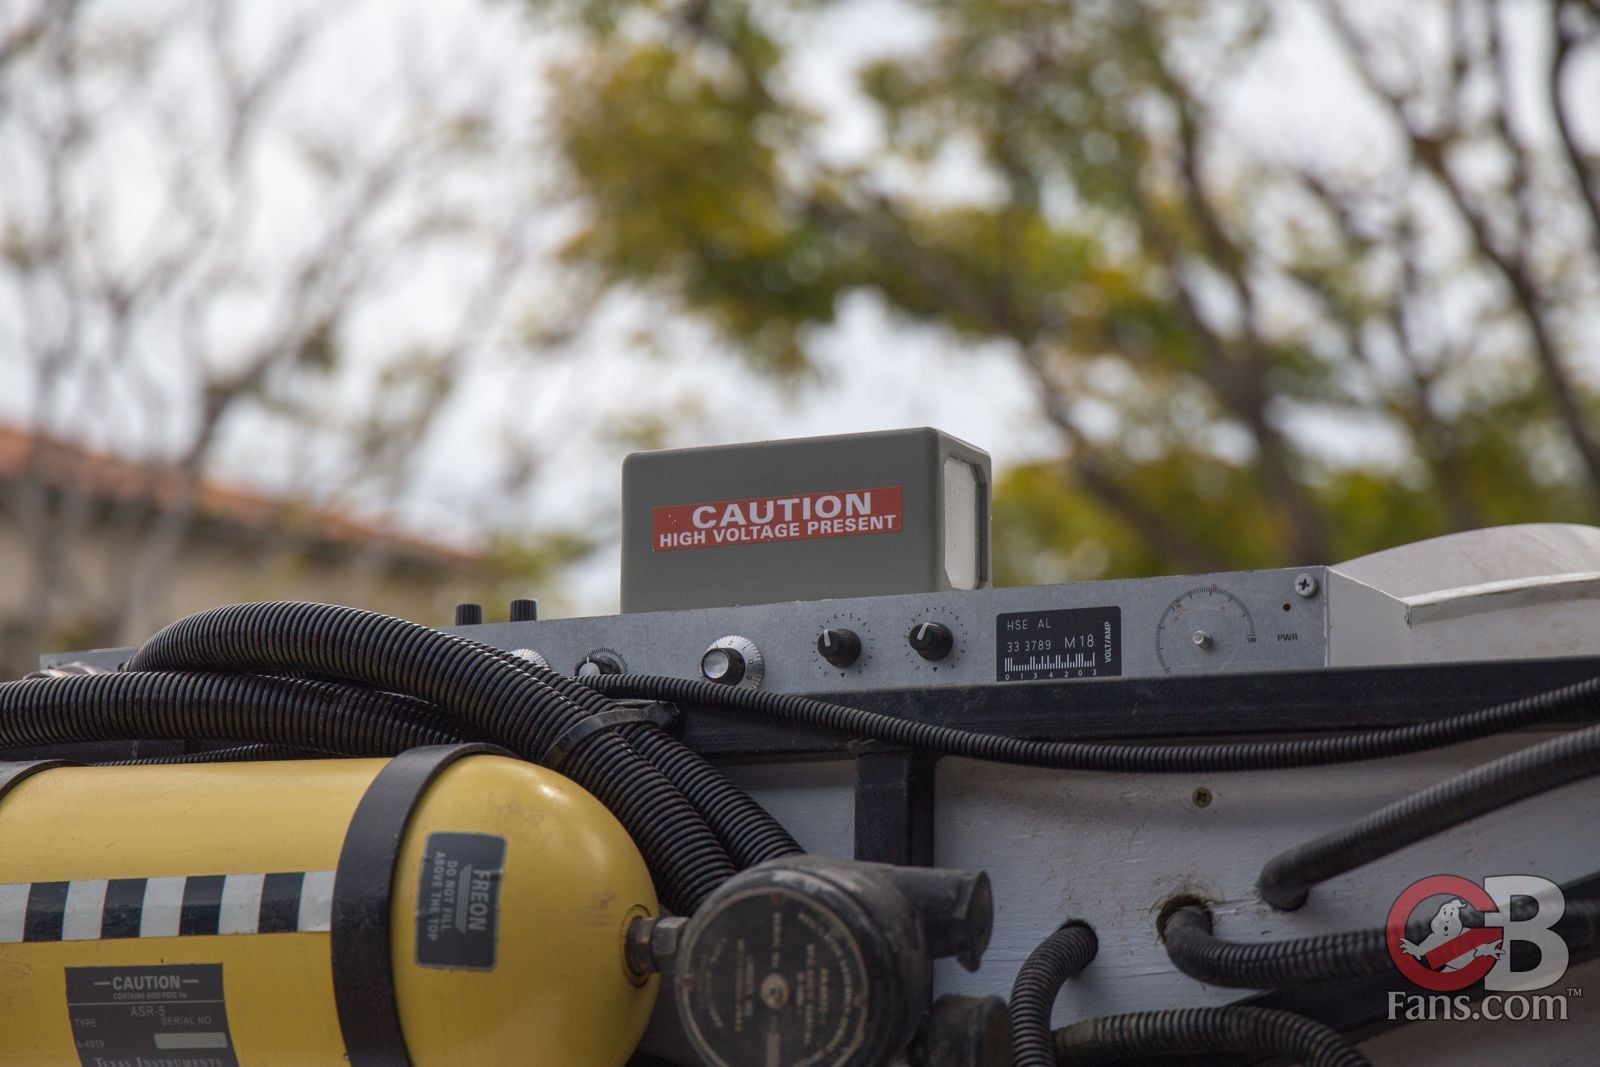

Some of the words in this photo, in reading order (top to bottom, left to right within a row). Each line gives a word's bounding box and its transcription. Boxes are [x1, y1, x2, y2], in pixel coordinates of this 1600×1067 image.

[692, 492, 872, 529] CAUTION
[659, 532, 706, 548] HIGH
[712, 523, 800, 543] VOLTAGE
[807, 514, 897, 536] PRESENT
[1007, 619, 1029, 631] HSE
[1038, 618, 1052, 629] AL
[1007, 641, 1020, 653] 33
[1025, 639, 1052, 652] 3789
[1104, 621, 1112, 663] VOLT/AMP
[1277, 633, 1298, 642] PWR
[432, 851, 446, 888] ABOVE
[446, 861, 458, 876] DO
[443, 881, 456, 904] NOT
[467, 869, 491, 931] FREON
[429, 893, 442, 913] THE
[427, 917, 439, 941] TOP
[440, 908, 453, 931] FILL
[112, 975, 180, 991] CAUTION
[130, 1006, 166, 1016] ASR-5
[161, 1016, 194, 1026] SERIAL
[74, 1018, 97, 1027] TYPE
